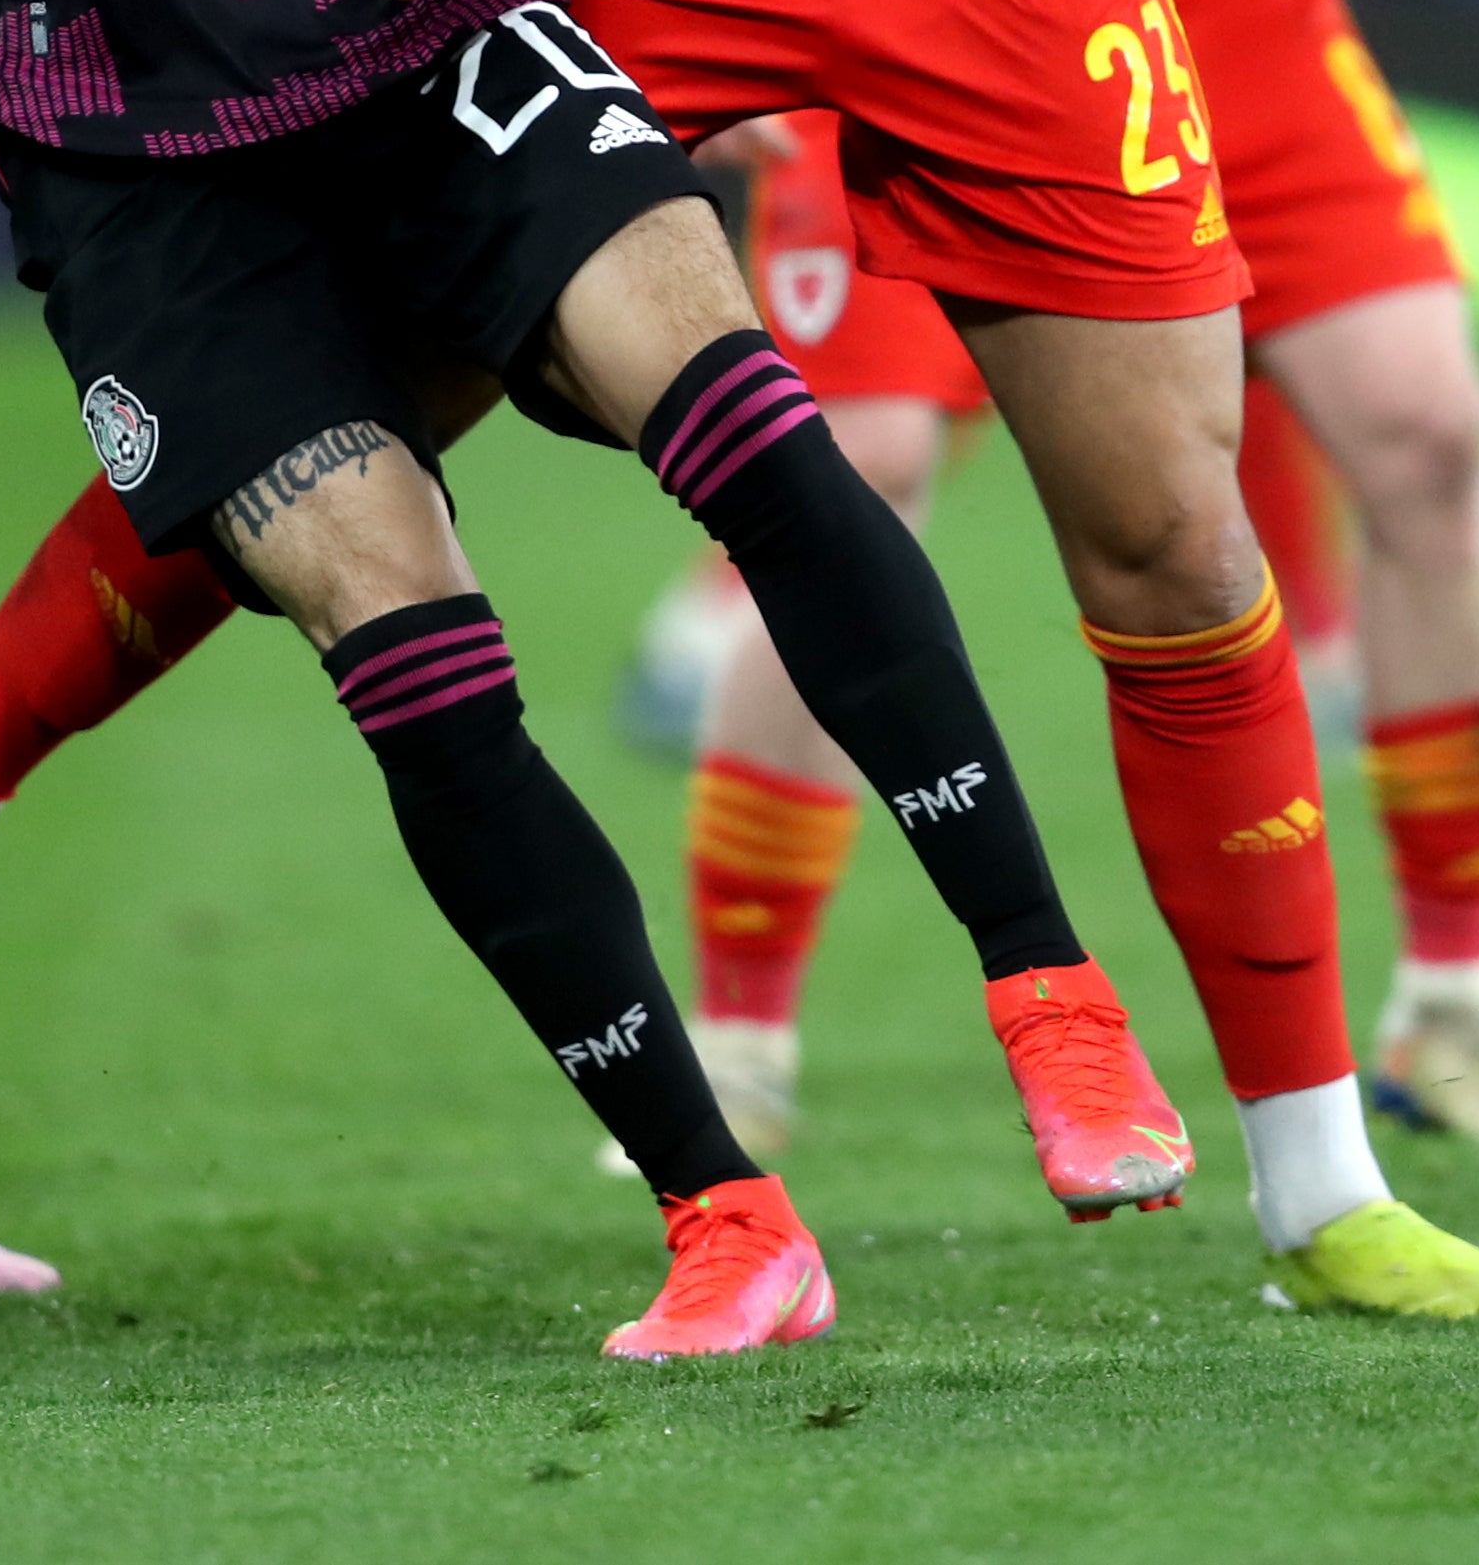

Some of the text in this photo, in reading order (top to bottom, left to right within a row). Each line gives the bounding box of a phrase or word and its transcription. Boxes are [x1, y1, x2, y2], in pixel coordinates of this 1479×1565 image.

[420, 1, 643, 156] 20
[893, 761, 988, 830] FMF
[556, 1002, 648, 1079] FMF
